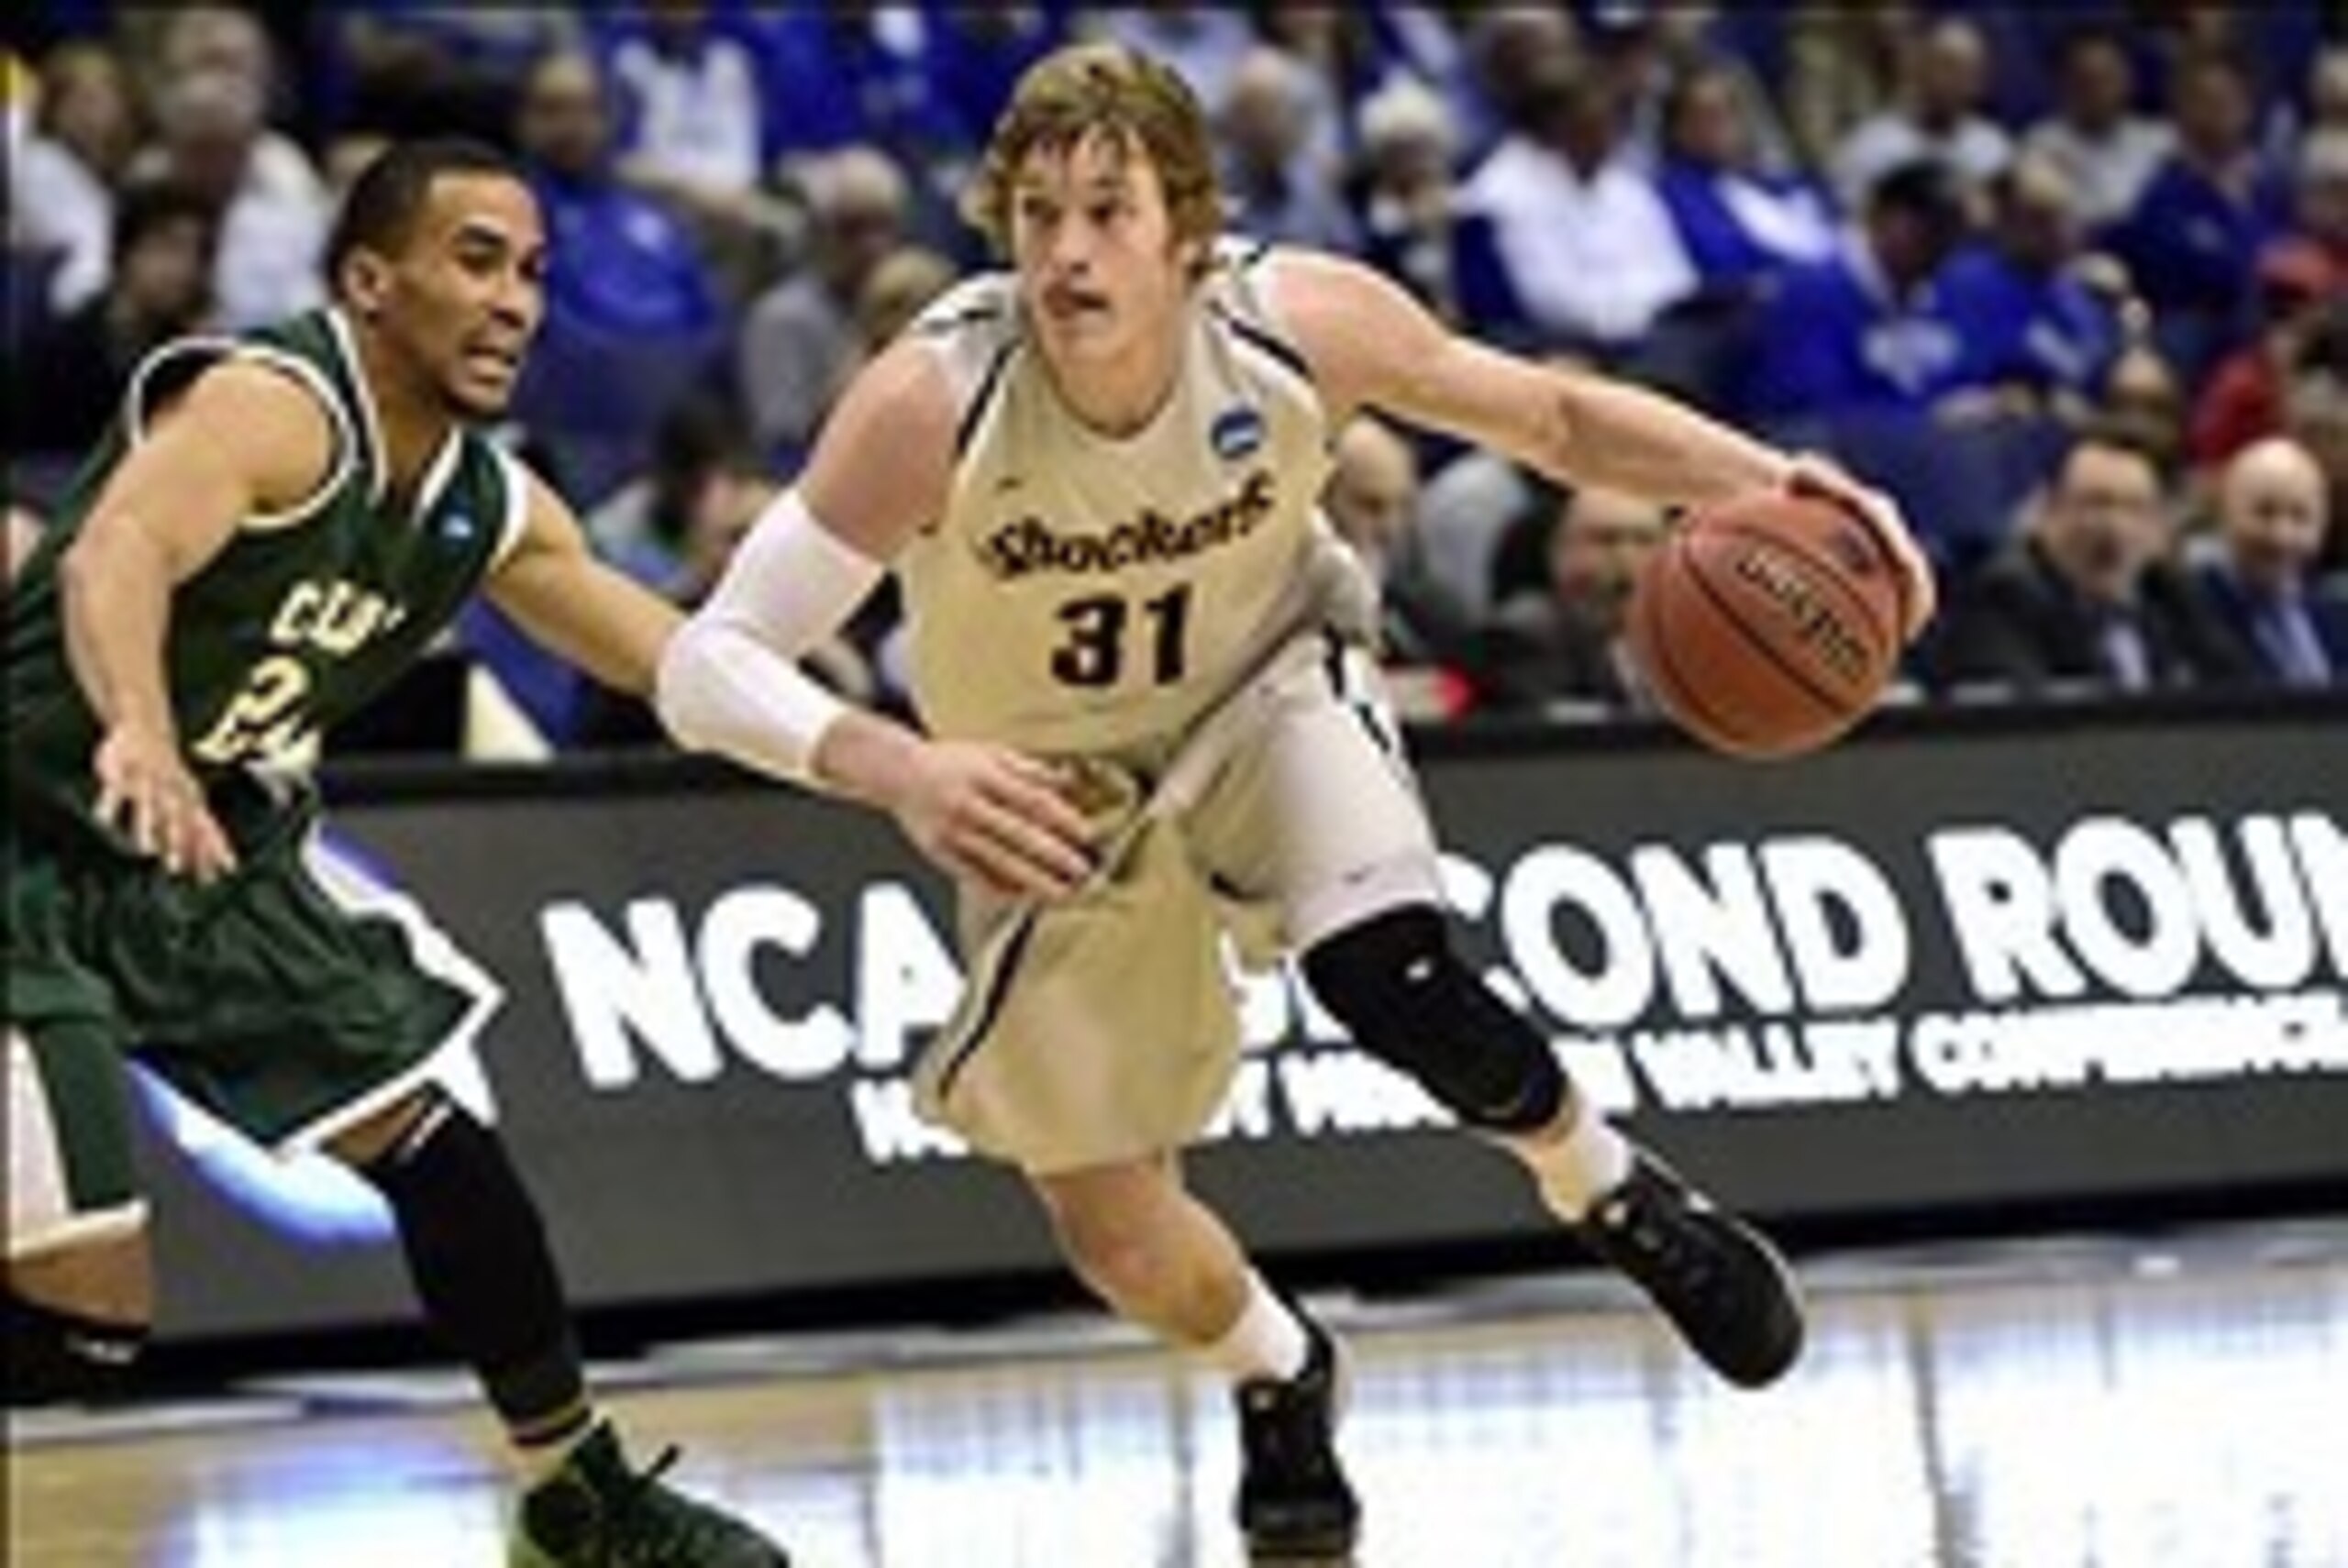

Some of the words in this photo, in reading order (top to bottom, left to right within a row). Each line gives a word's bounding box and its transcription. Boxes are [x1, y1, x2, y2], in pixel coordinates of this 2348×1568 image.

[1050, 582, 1193, 689] 31
[540, 883, 969, 1089] NCA
[1632, 1016, 1900, 1110] VALLEY
